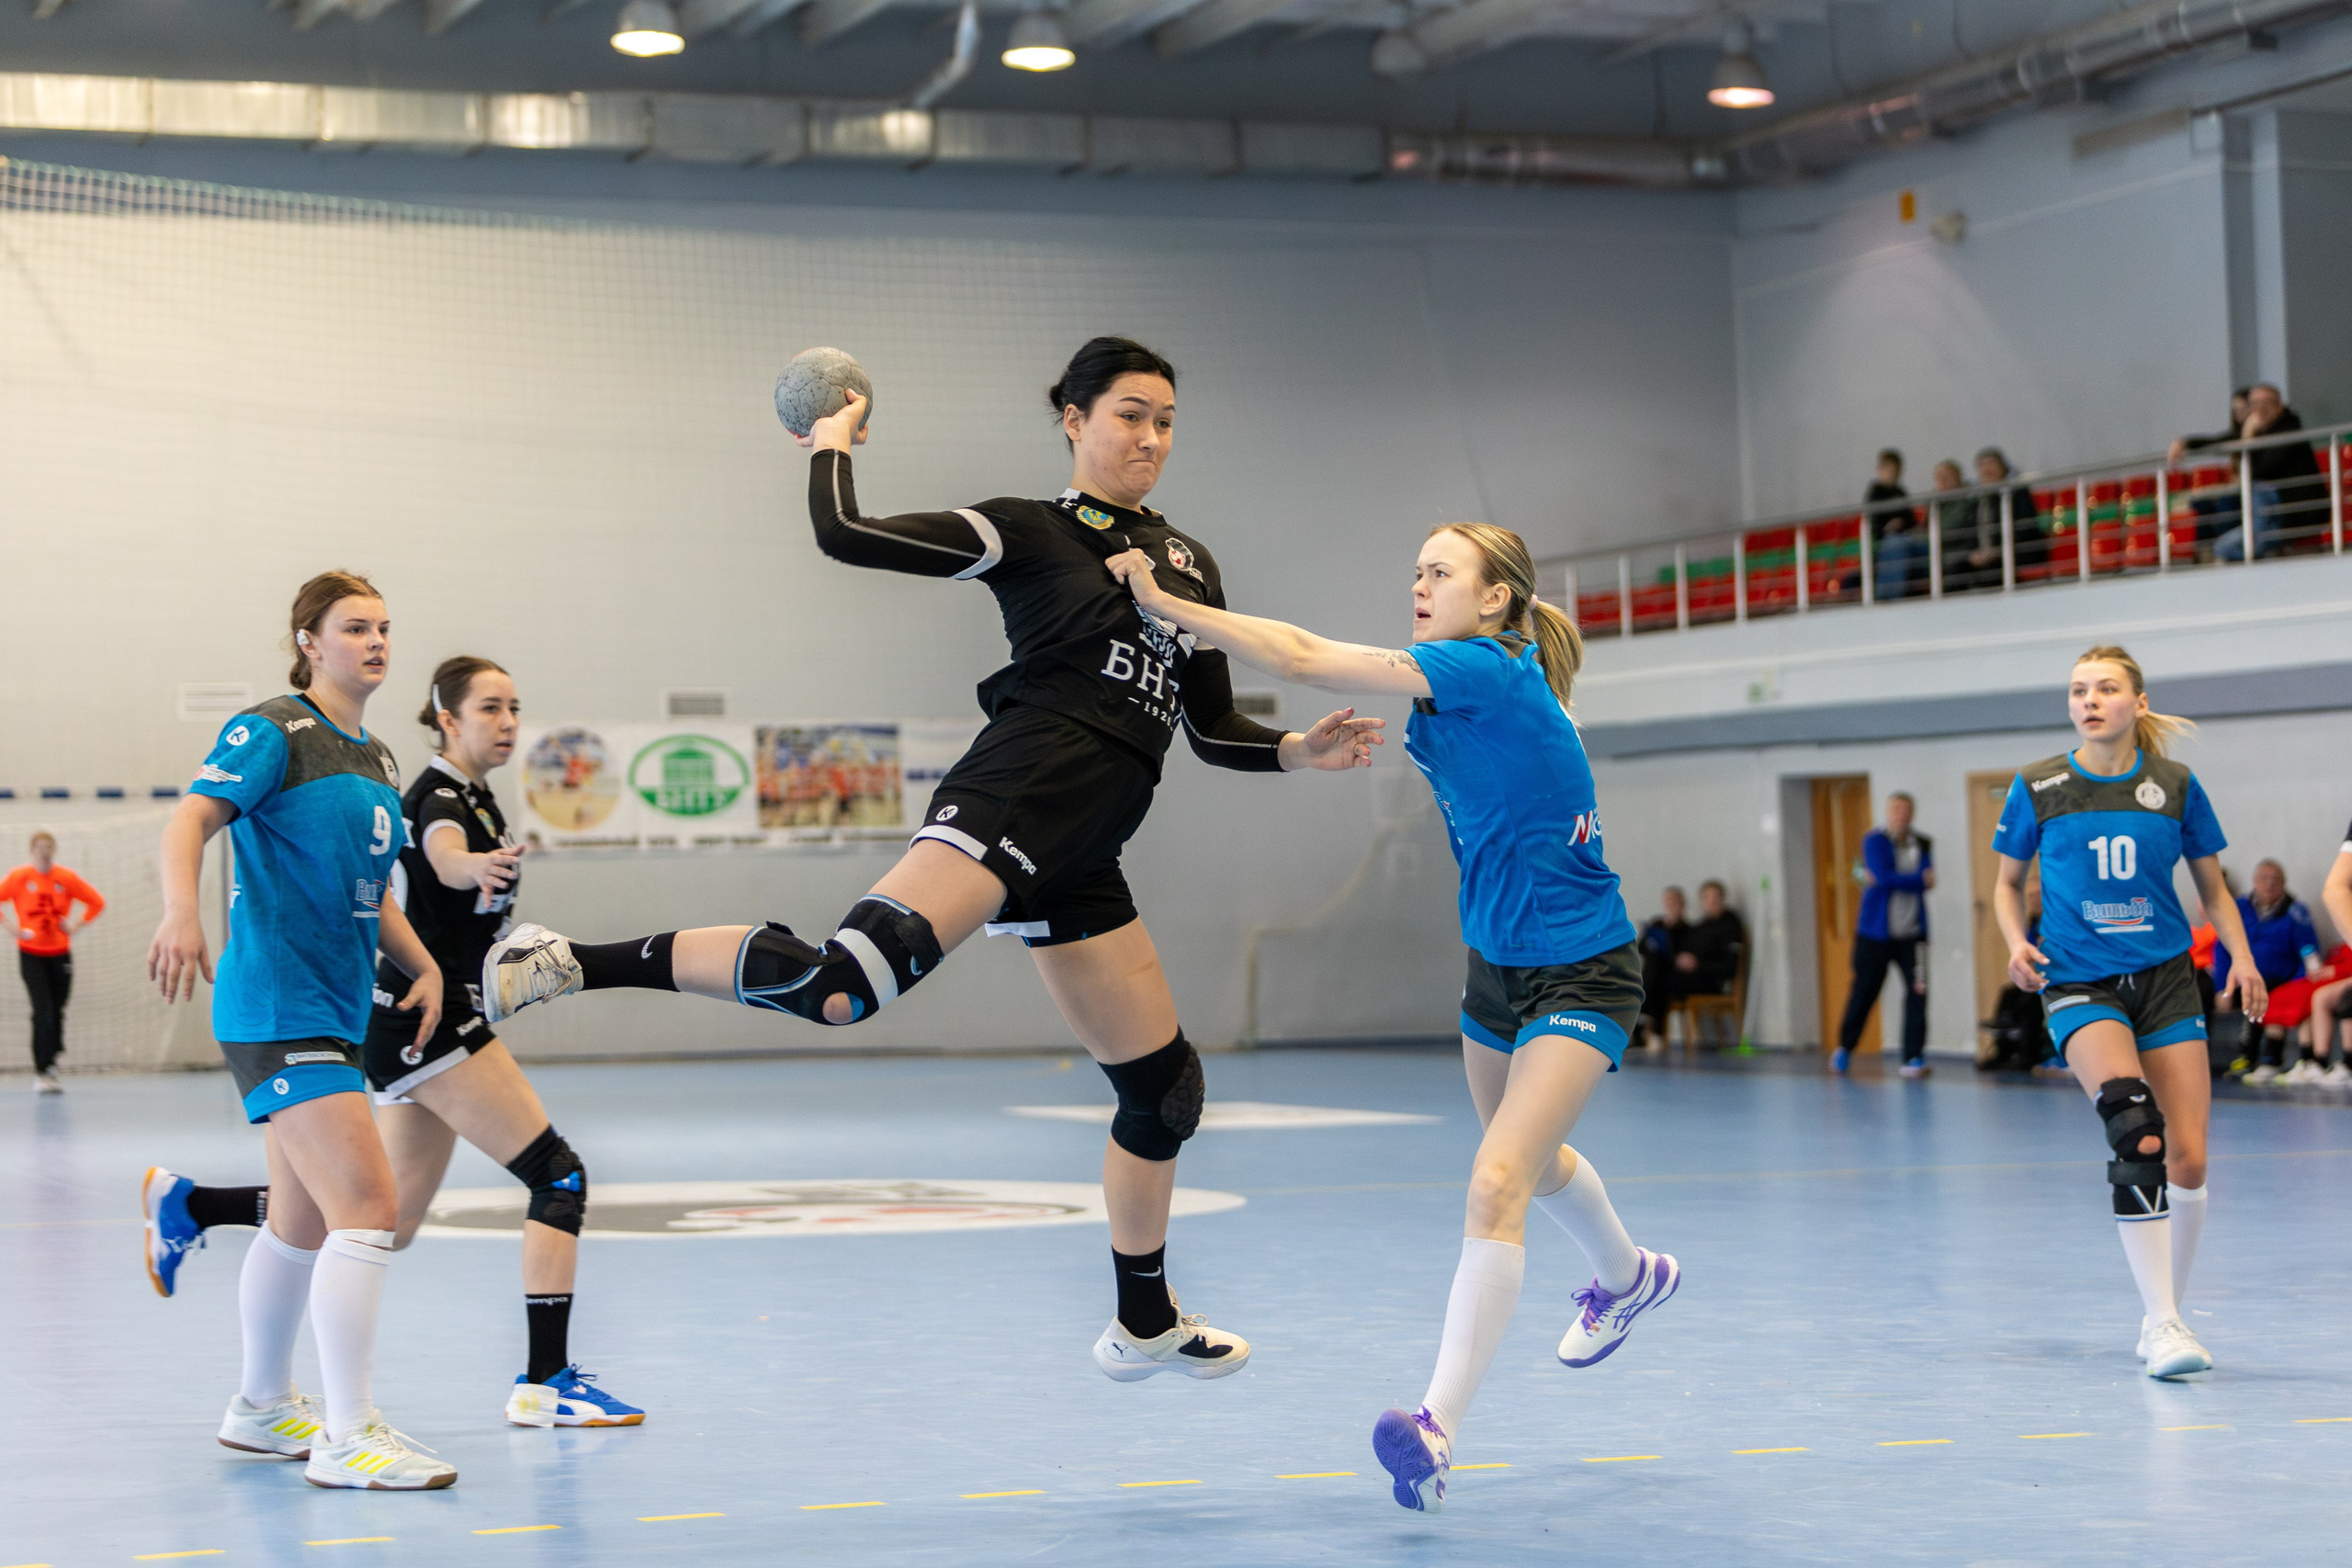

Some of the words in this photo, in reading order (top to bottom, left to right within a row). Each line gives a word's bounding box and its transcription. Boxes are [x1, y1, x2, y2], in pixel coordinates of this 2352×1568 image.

[369, 806, 391, 855] 9
[999, 836, 1037, 875] Kempa
[2087, 835, 2137, 881] 10
[1549, 1014, 1597, 1032] Kempa
[526, 1296, 569, 1306] empa
